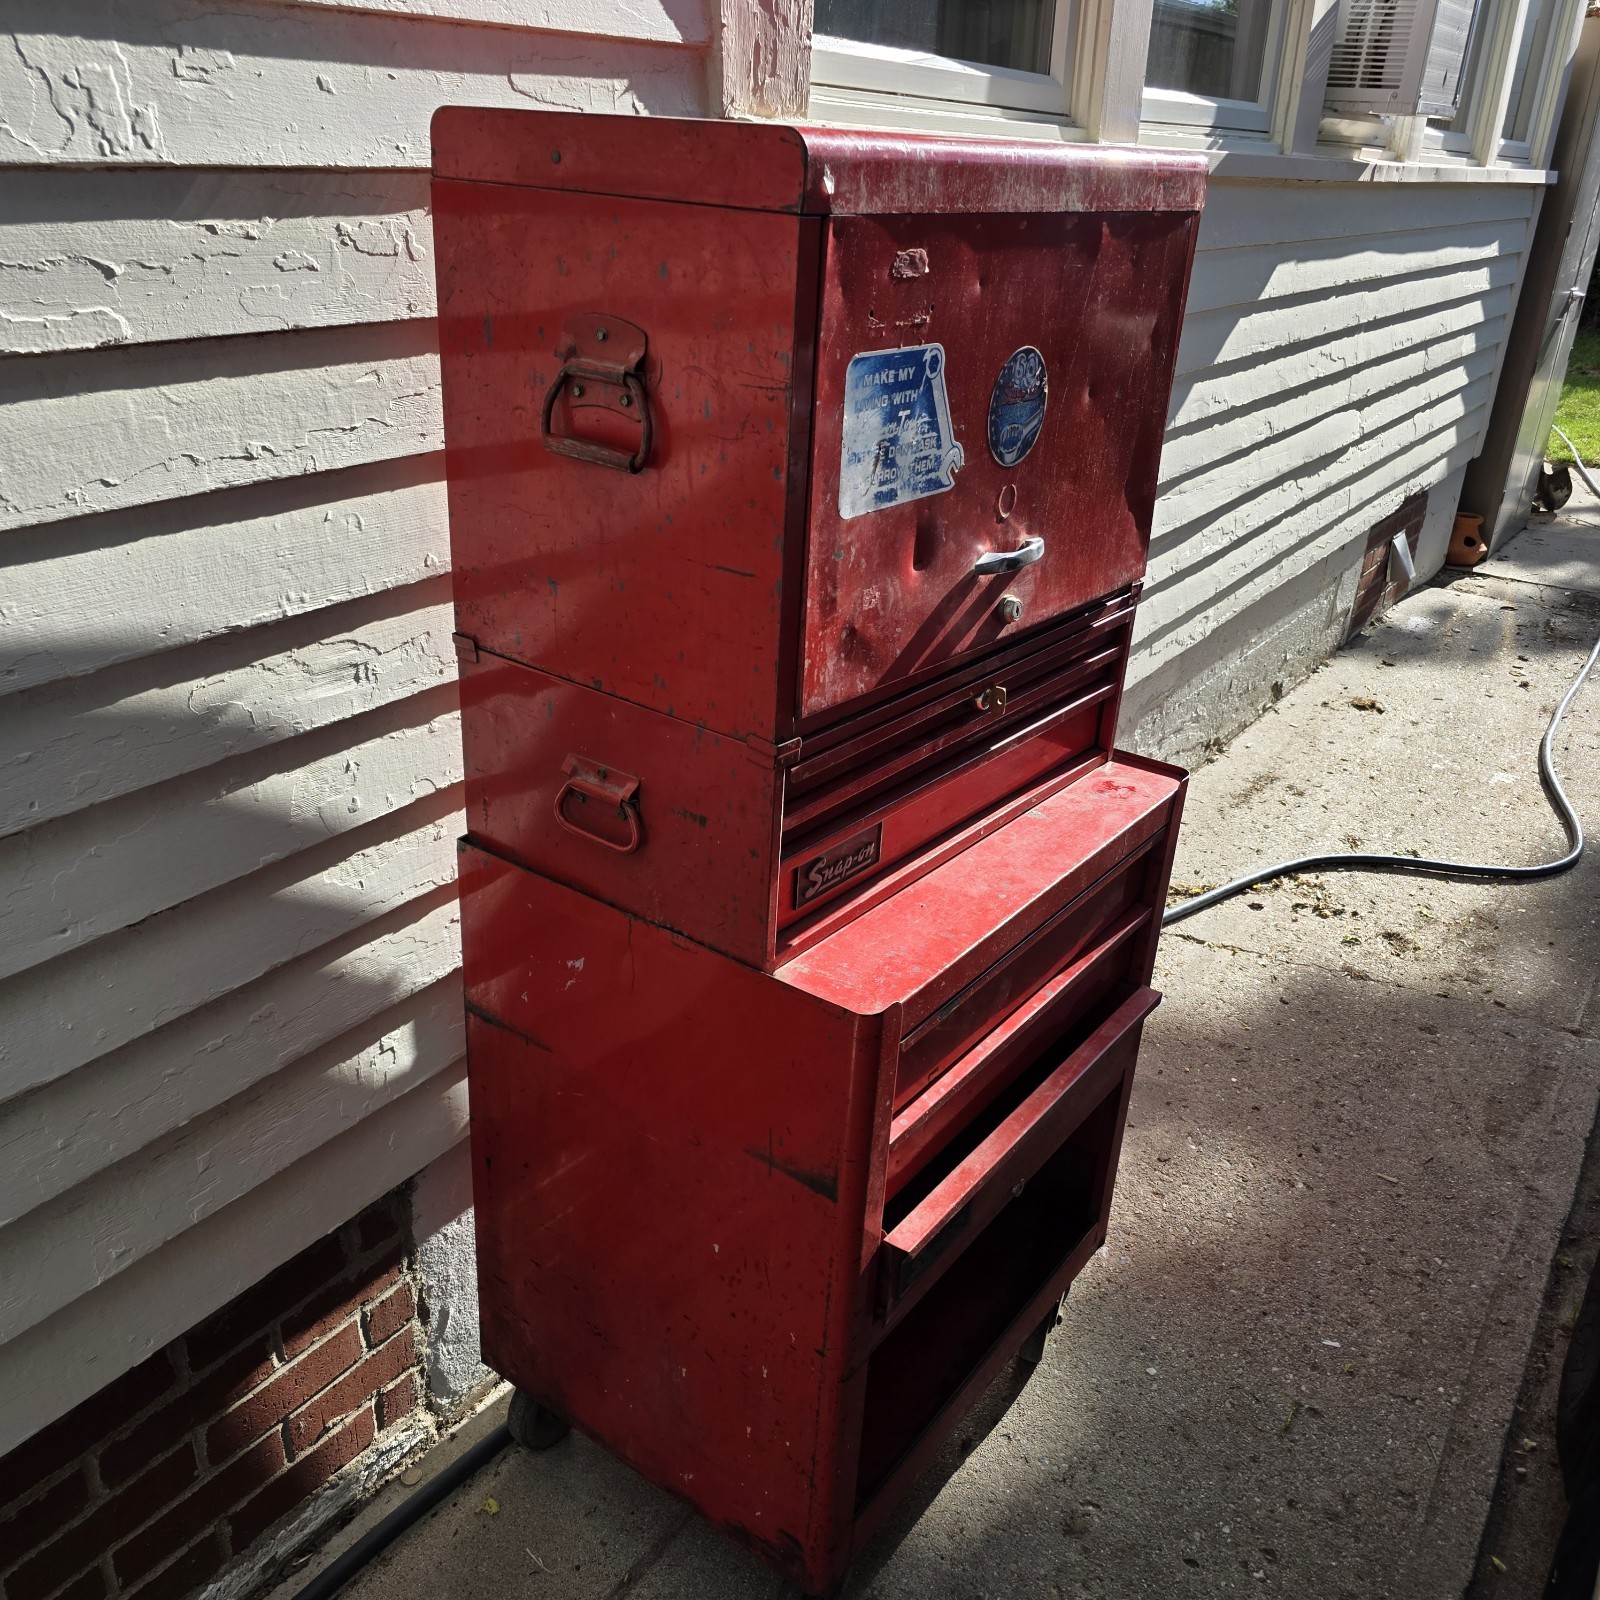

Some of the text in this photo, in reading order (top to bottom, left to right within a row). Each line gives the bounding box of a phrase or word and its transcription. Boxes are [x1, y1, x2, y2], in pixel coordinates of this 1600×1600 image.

[863, 369, 895, 387] MAKE
[898, 367, 916, 382] MY
[854, 389, 919, 413] LIVING WITH
[919, 436, 937, 453] ASK
[909, 457, 935, 474] THEM
[804, 842, 876, 899] Snap-on
